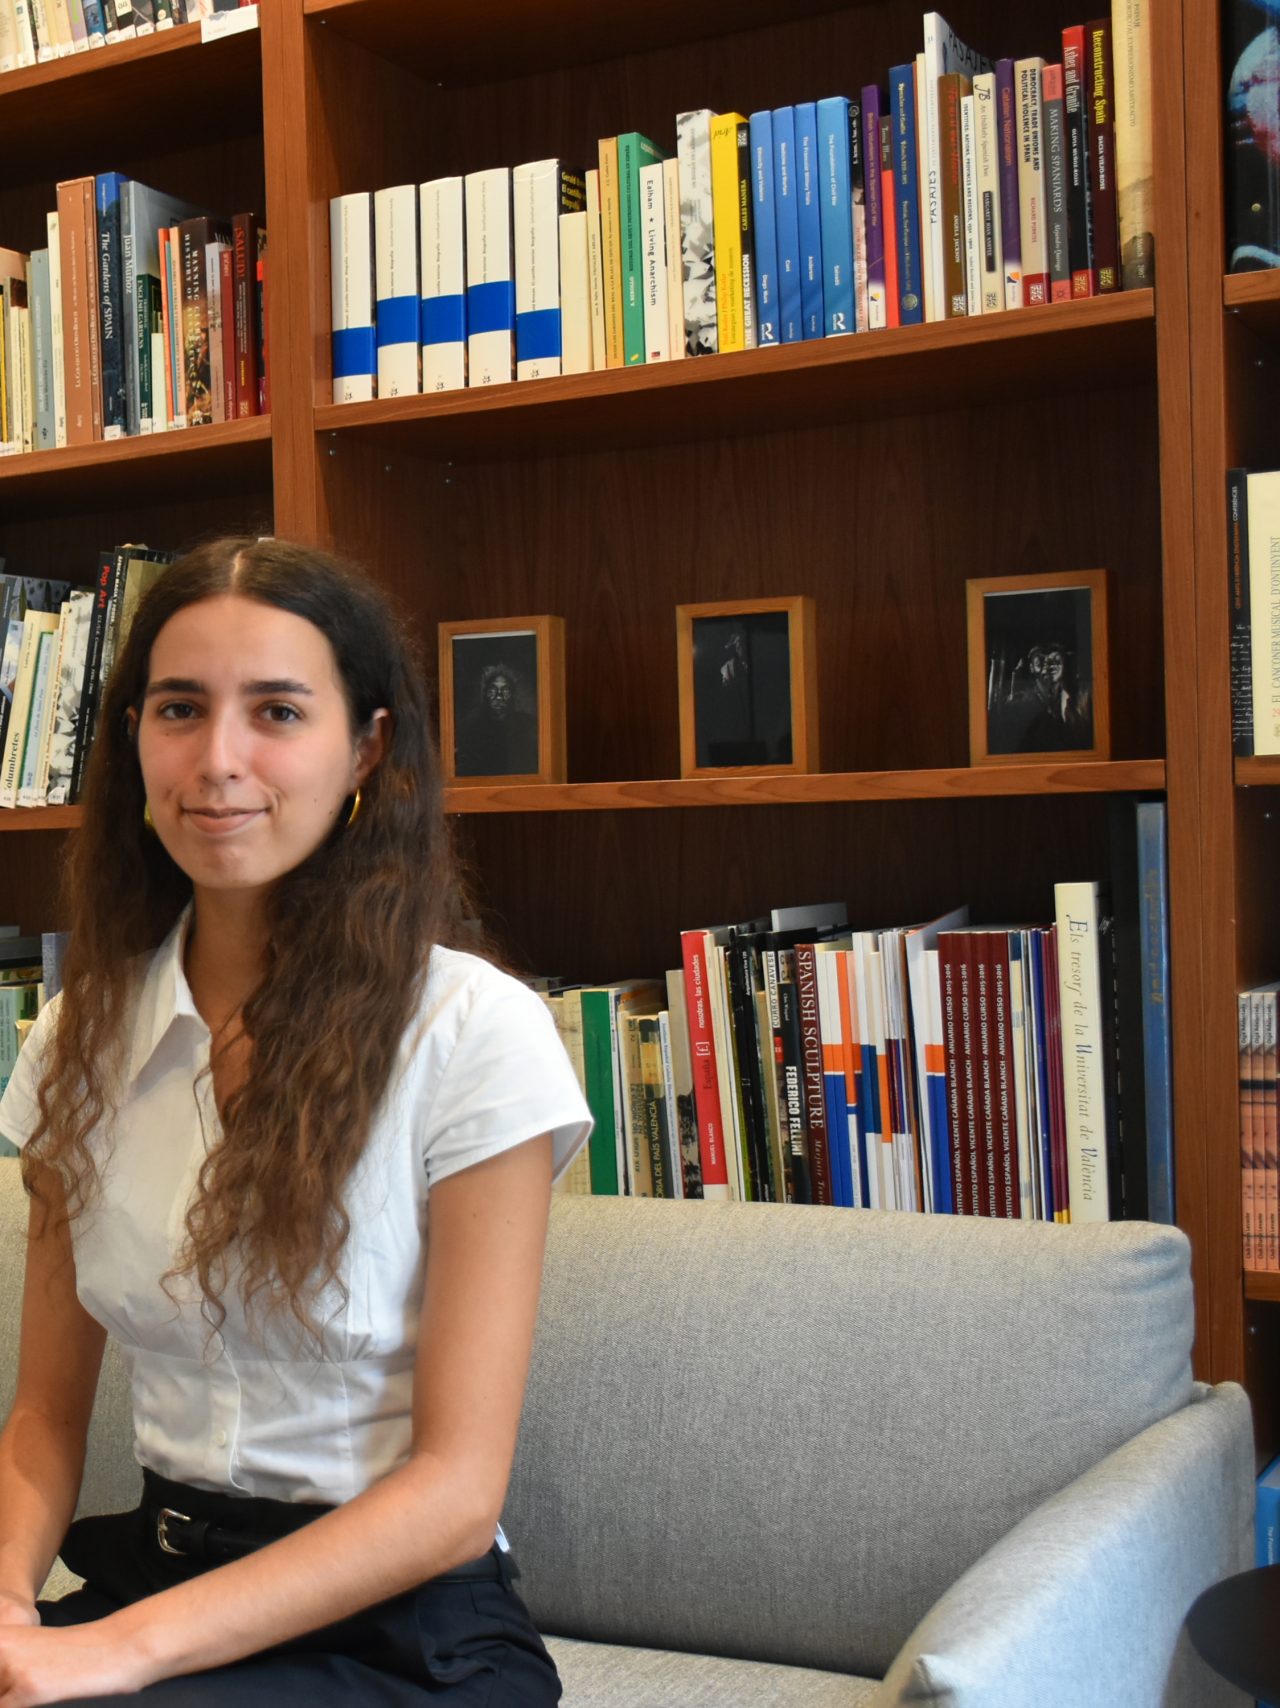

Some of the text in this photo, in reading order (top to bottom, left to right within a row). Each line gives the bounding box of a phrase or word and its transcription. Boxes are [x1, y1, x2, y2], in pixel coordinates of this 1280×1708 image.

[1064, 46, 1080, 114] Ashes and Granite
[1092, 28, 1108, 126] Reconstructing Spain
[1020, 69, 1032, 163] POLITICAL VIOLENCE IN SPAIN
[1029, 68, 1041, 171] DEMOCRACY, TRADE UNIONS AND
[1049, 108, 1063, 213] MAKING SPANIARDS
[123, 233, 133, 259] Juan
[192, 249, 200, 301] MANNING
[646, 180, 659, 306] Ealham Living Anarchism
[101, 232, 113, 340] The Gardens of SPAIN
[185, 287, 192, 301] OF
[742, 254, 753, 345] THE GREAT RECESSION
[98, 565, 111, 609] Pop Art
[4, 732, 21, 791] olumbretes
[692, 954, 701, 985] ciudades
[694, 985, 702, 997] las
[944, 963, 952, 995] 2015-2016
[702, 1059, 713, 1090] España
[798, 951, 824, 1129] SPANISH SCULPTURE
[947, 1022, 955, 1055] ANUARIO
[949, 1059, 957, 1088] BLANCH
[960, 963, 978, 1184] ESPAÑOL VICENTE CAÑADA BLANCH ANUARIO CURSO 2015-2016
[978, 963, 995, 1184] ESPAÑOL VICENTE CAÑADA BLANCH ANUARIO CURSO 2015-2016
[995, 963, 1011, 1185] ESPAÑOL VICENTE CAÑADA BLANCH ANUARIO CURSO 2015-2016
[1066, 913, 1097, 1202] Els de la Universitat de València
[649, 1100, 662, 1177] DEL PAÍS VALENCIÀ
[785, 1065, 803, 1156] FEDERICO FELLINI
[950, 1088, 958, 1119] CAÑADA
[953, 1151, 961, 1182] ESPAÑOL
